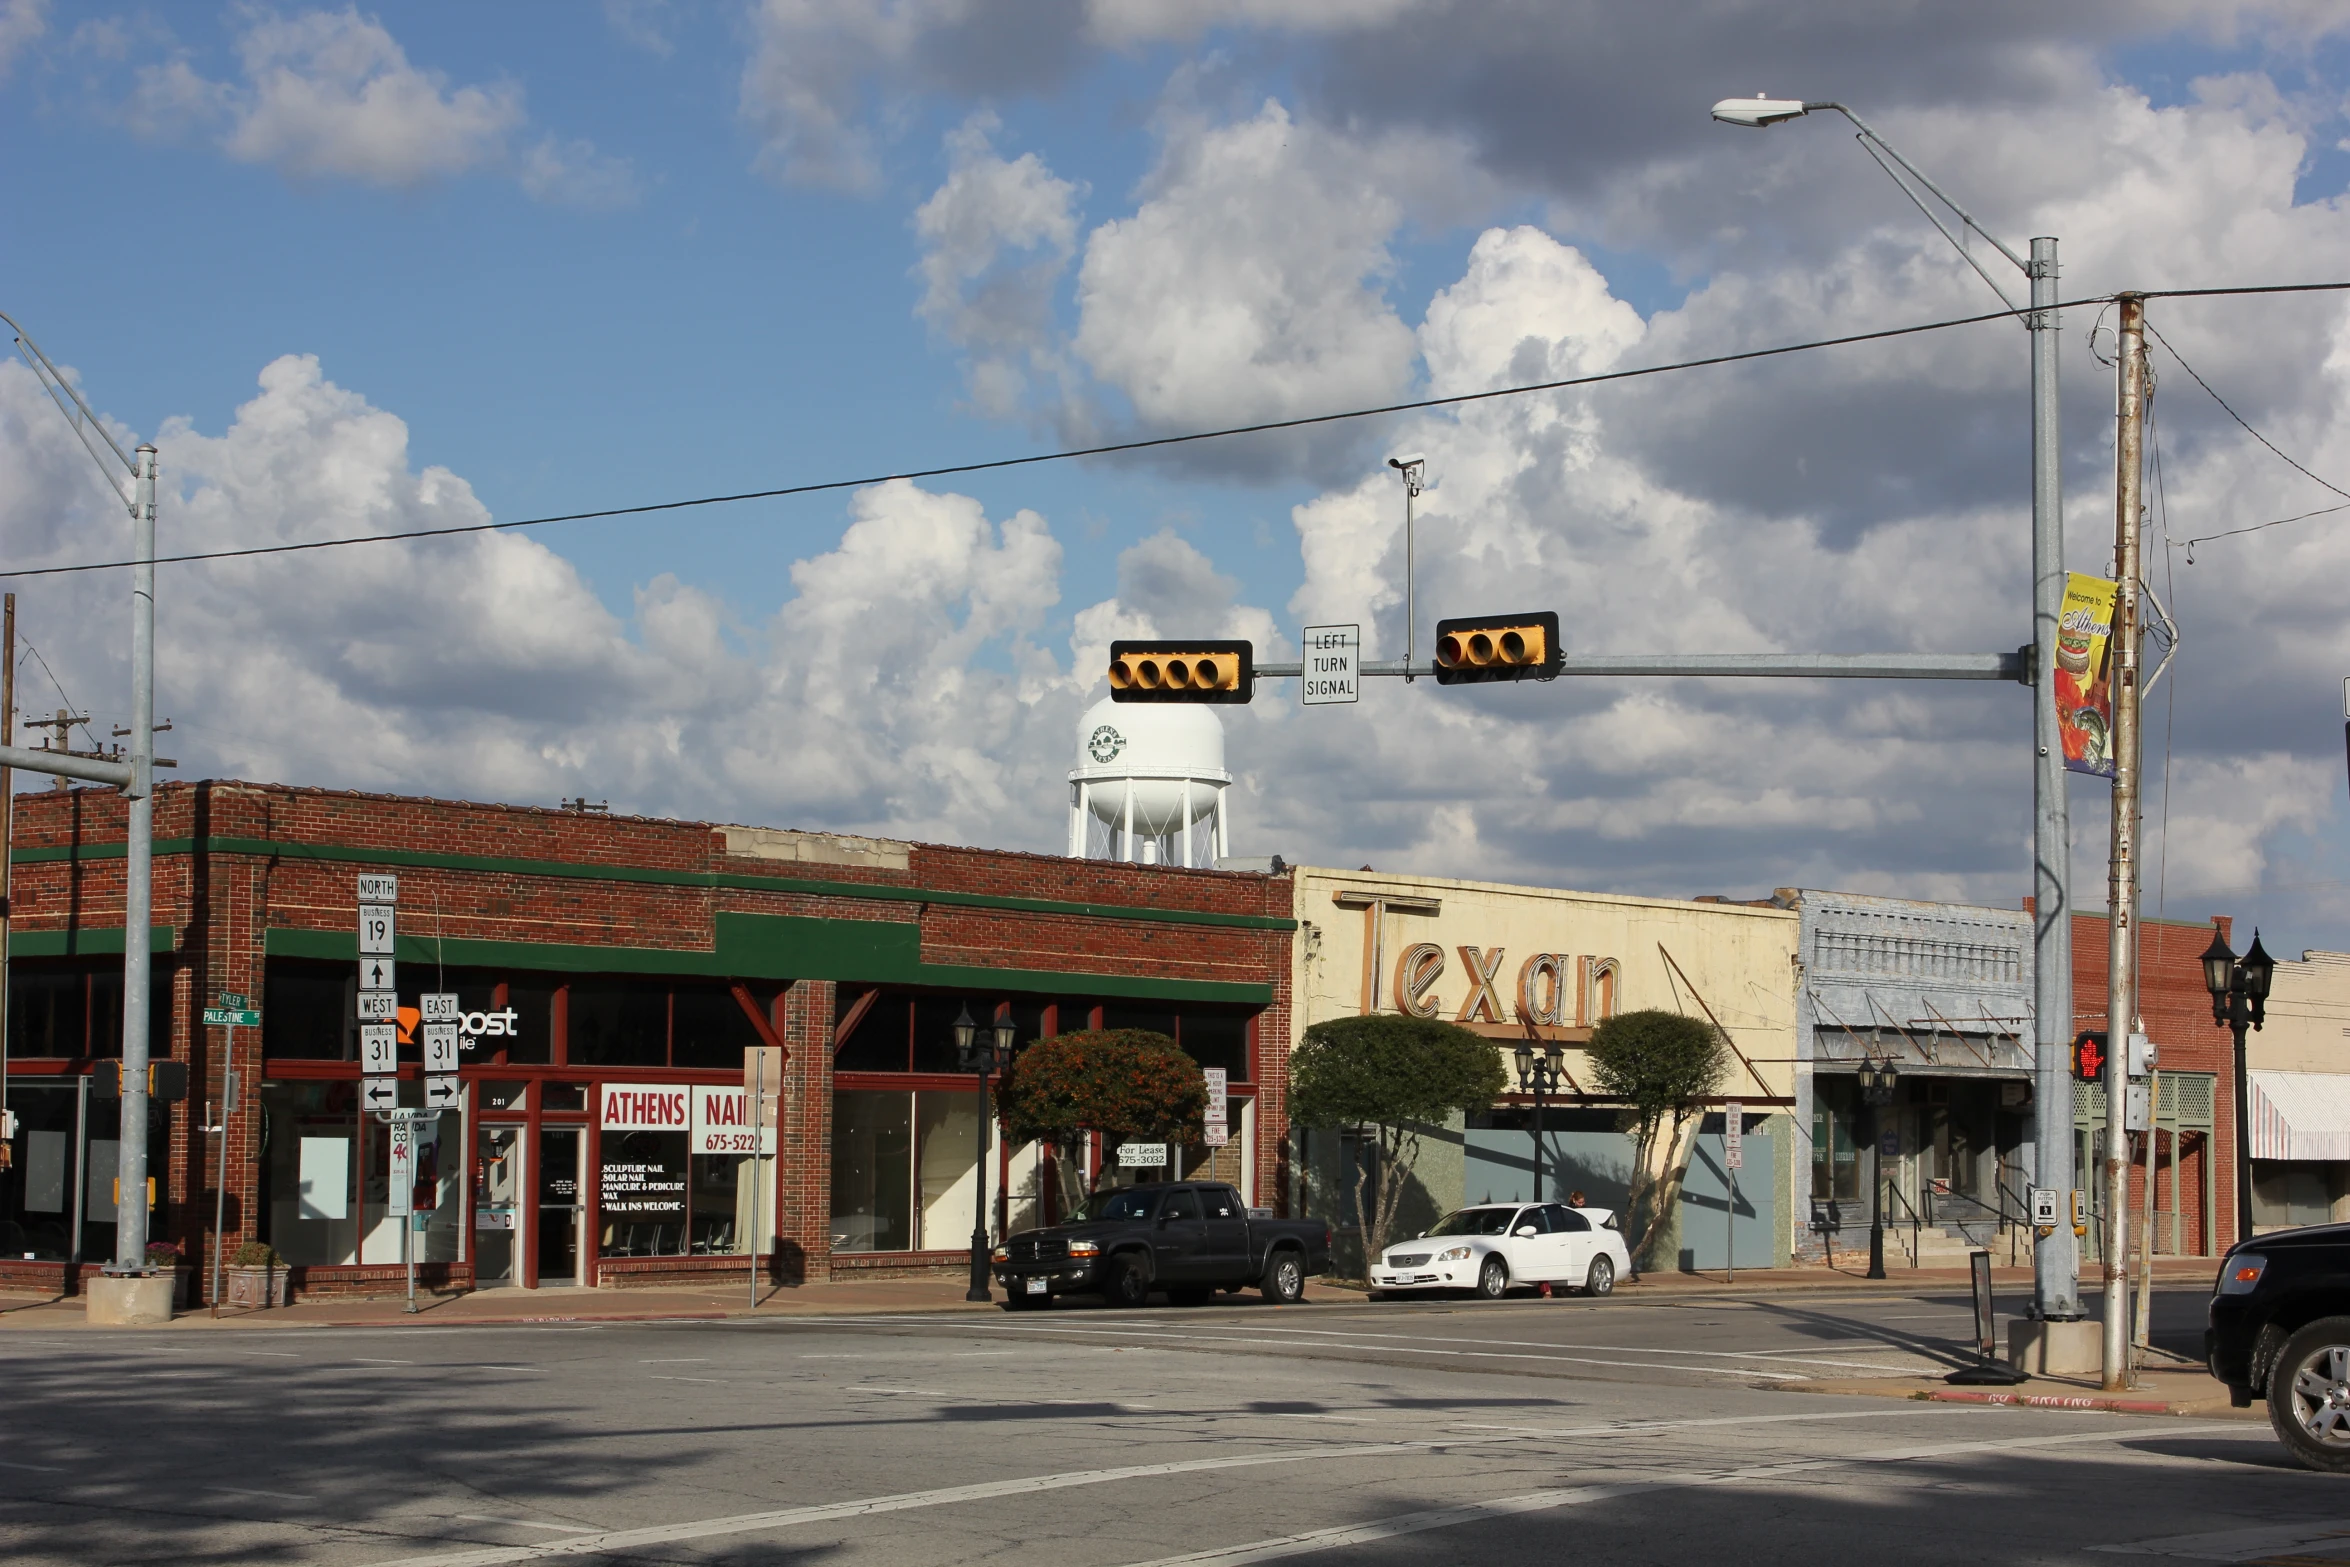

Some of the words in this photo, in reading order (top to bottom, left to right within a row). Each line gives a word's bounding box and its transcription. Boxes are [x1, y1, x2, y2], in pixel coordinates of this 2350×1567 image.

[2067, 590, 2094, 605] Welcome
[2095, 596, 2102, 606] to
[2062, 607, 2111, 636] Athens
[1316, 634, 1346, 650] LEFT
[1314, 657, 1347, 673] TURN
[1307, 680, 1354, 696] SIGNAL
[360, 879, 394, 895] NORTH
[363, 908, 390, 918] BUSINESS
[369, 920, 386, 941] 19
[1332, 889, 1622, 1028] Texan
[221, 993, 241, 1007] TYLER
[363, 998, 392, 1013] WEST
[427, 999, 453, 1014] EAST
[203, 1011, 245, 1023] PALESTINE
[457, 1007, 518, 1036] ost
[365, 1028, 392, 1037] BUSINESS
[427, 1027, 453, 1036] BUSINESS
[371, 1039, 389, 1060] 31
[433, 1038, 450, 1060] 31
[459, 1036, 475, 1050] ile
[492, 1098, 505, 1106] 201
[604, 1092, 685, 1125] ATHENS
[706, 1094, 746, 1126] NAI
[394, 1123, 427, 1132] RAIDA
[393, 1133, 414, 1142] CO
[1119, 1145, 1135, 1155] For
[1138, 1145, 1164, 1154] Lease
[647, 1164, 664, 1173] NAIL
[628, 1173, 646, 1182] NAIL
[641, 1182, 648, 1191] &
[648, 1182, 685, 1191] PEDICURE
[628, 1202, 642, 1211] INS
